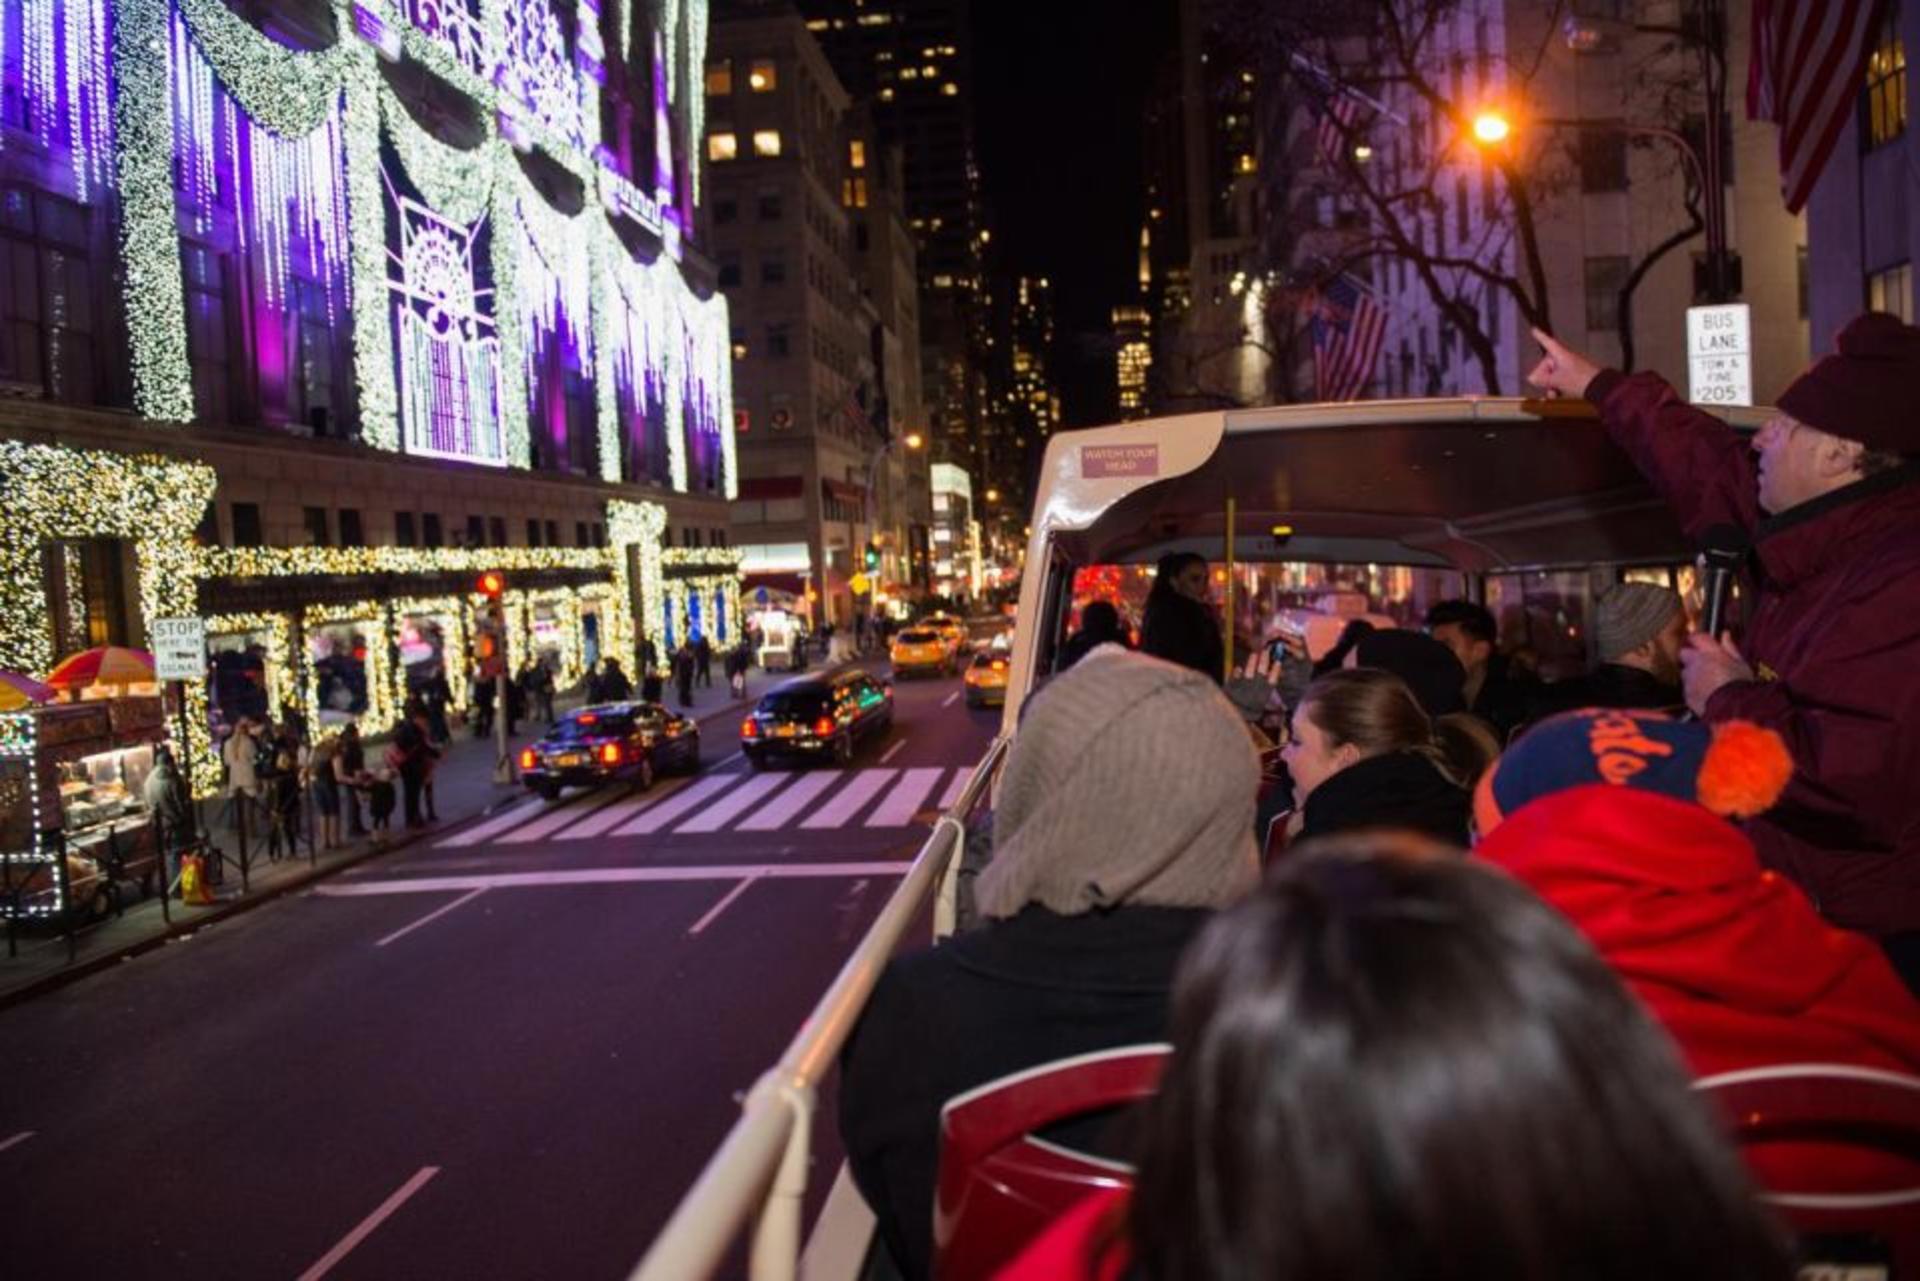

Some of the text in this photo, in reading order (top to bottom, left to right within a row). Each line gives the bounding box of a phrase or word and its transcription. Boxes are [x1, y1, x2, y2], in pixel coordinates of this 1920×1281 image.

[1703, 312, 1734, 330] BUS
[1699, 333, 1739, 351] LANE
[1085, 447, 1124, 460] WATCH
[155, 622, 199, 636] STOP
[160, 662, 201, 673] SIGNAL
